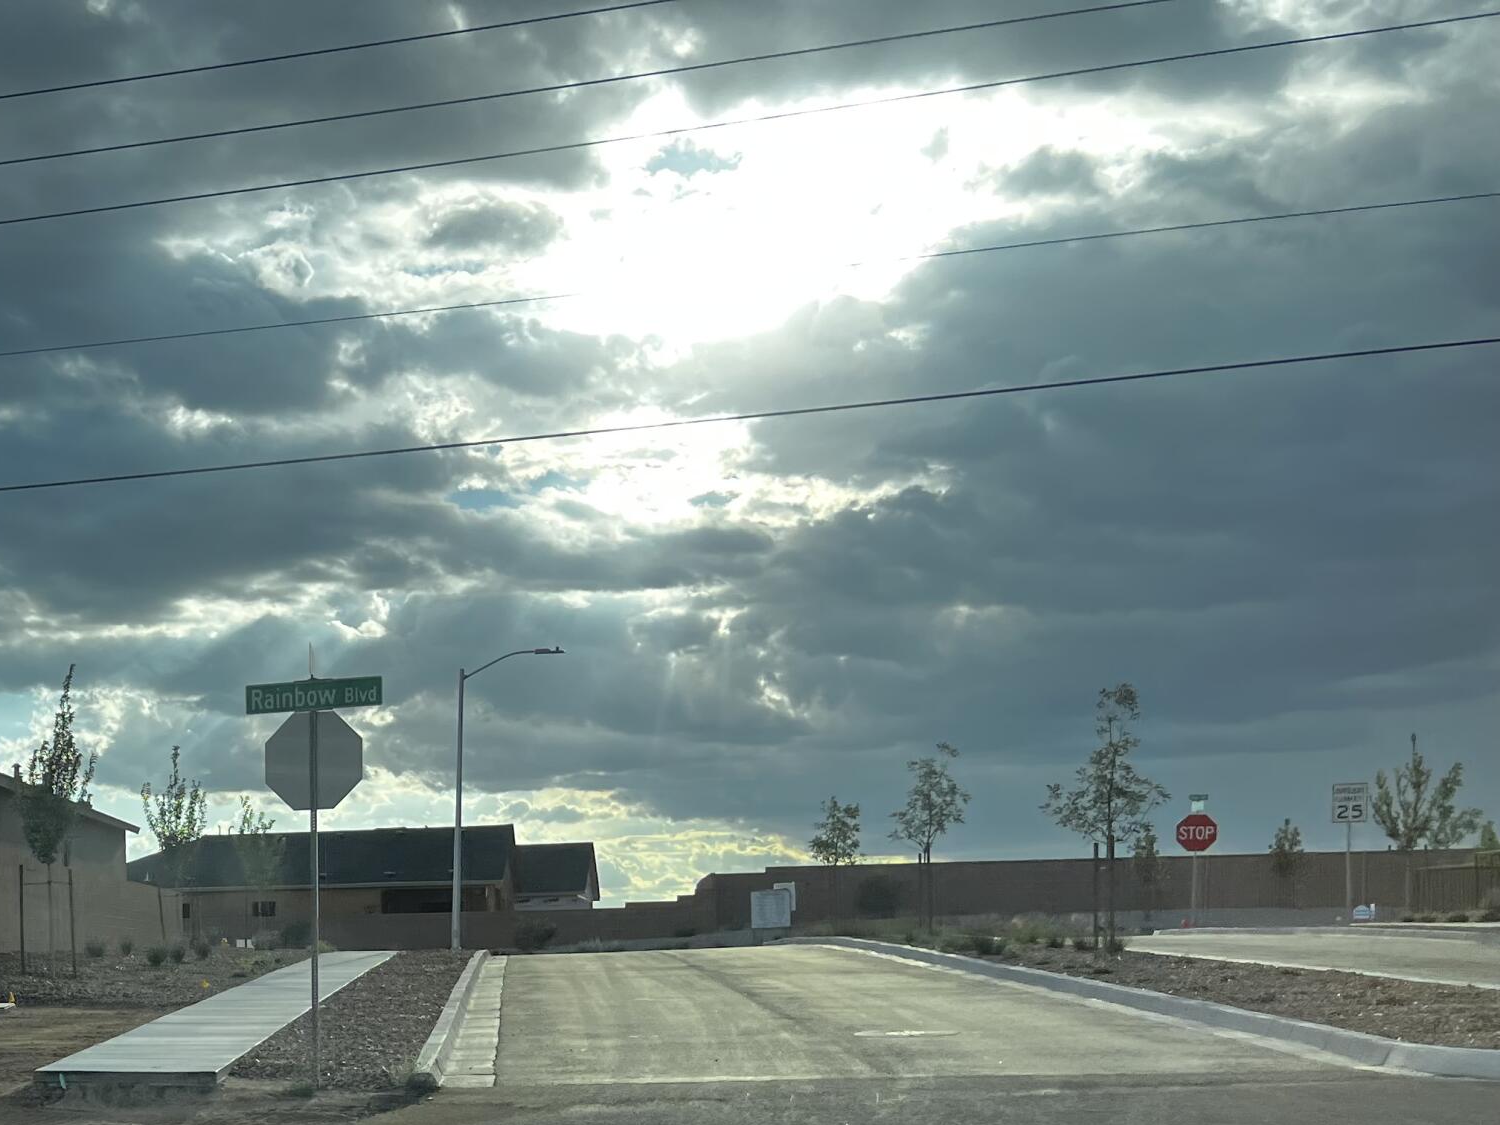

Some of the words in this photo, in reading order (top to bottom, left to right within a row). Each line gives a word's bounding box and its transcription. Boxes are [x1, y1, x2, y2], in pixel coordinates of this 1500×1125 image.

[251, 687, 336, 711] Rainbow
[344, 686, 377, 704] Blvd
[1337, 804, 1363, 819] 25
[1178, 825, 1215, 841] STOP
